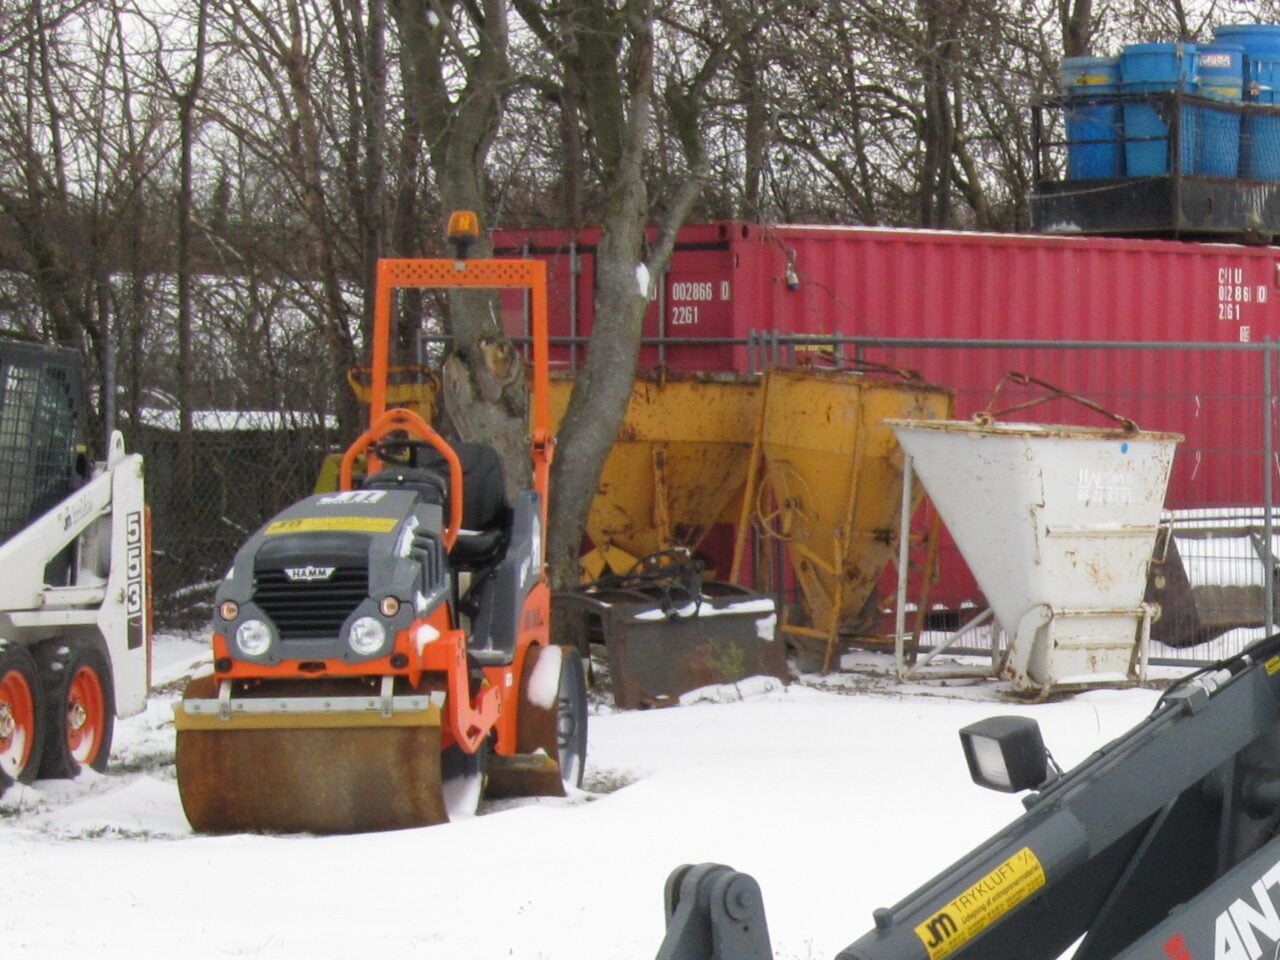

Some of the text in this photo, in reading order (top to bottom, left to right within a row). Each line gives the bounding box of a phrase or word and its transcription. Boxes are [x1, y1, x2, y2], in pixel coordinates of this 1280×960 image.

[672, 282, 712, 301] 002866
[126, 511, 143, 615] 553
[292, 569, 327, 579] HAMM
[951, 862, 1015, 913] TRYKLUFT
